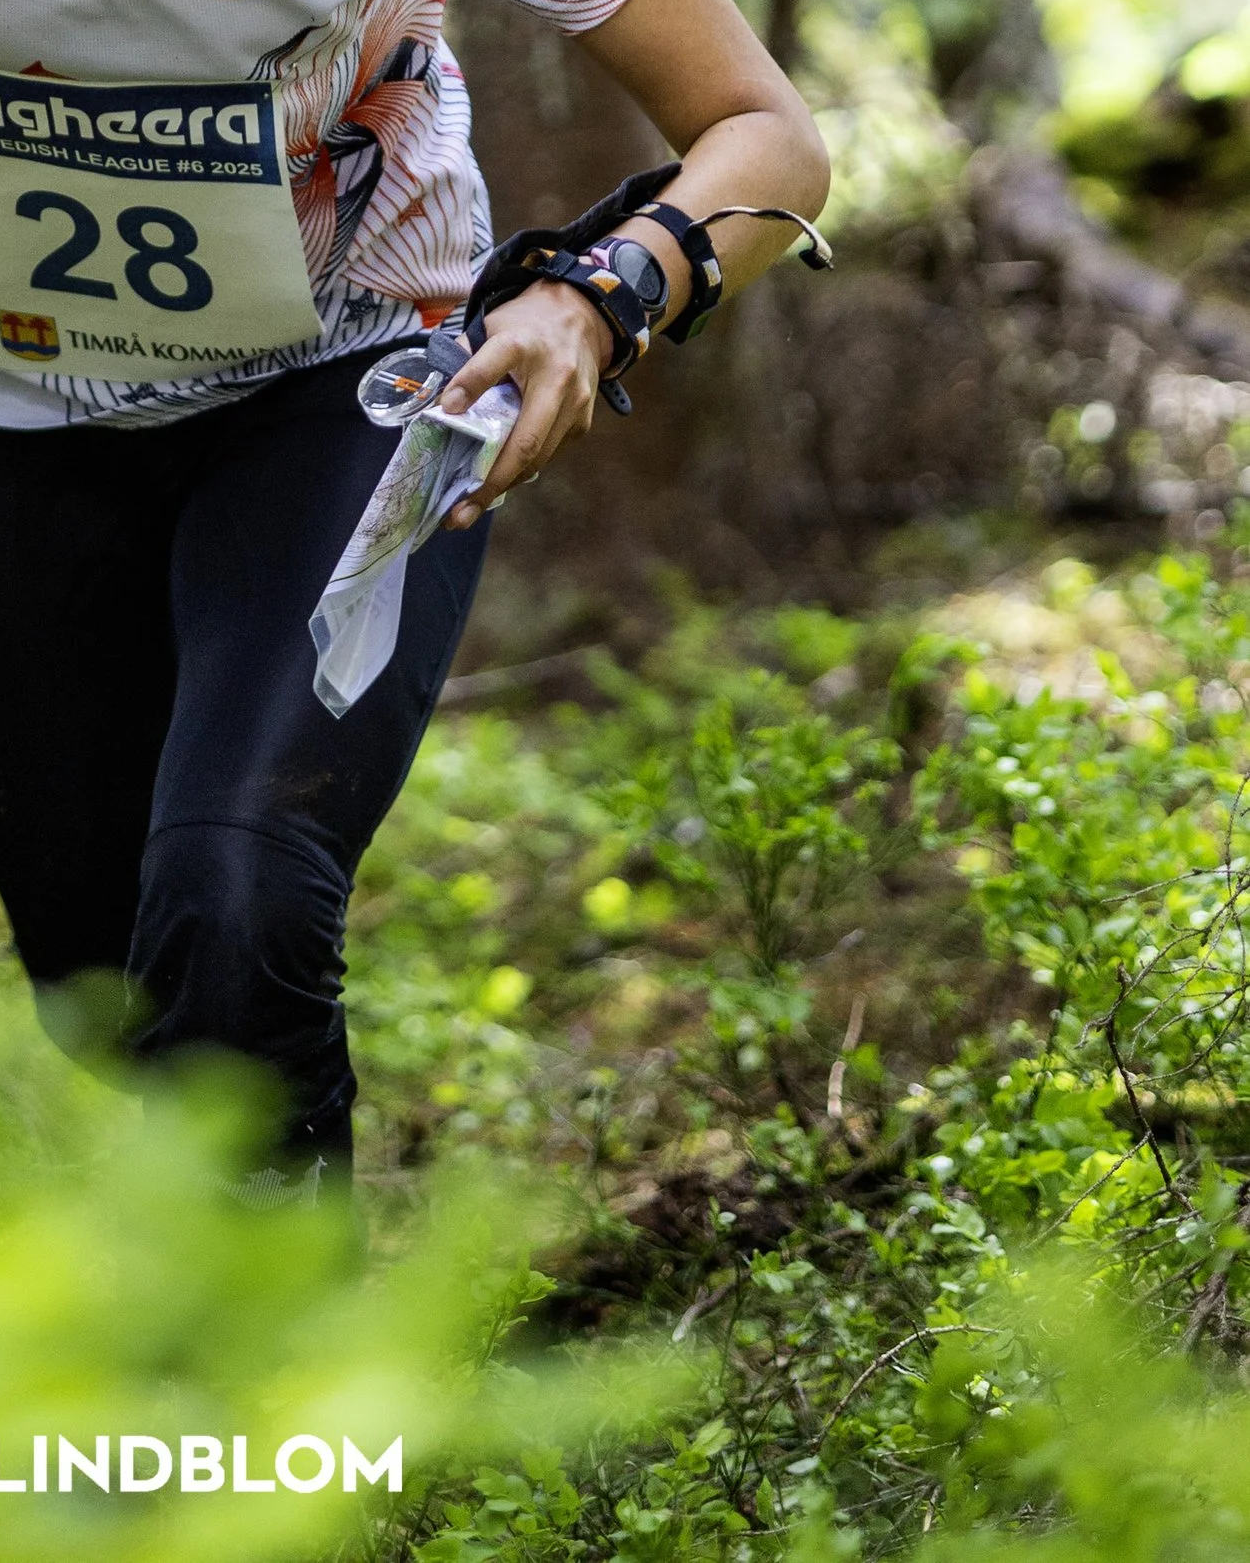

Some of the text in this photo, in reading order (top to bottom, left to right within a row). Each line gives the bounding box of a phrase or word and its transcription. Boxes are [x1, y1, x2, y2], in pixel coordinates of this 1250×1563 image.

[75, 150, 170, 174] LEAGUE
[176, 160, 204, 175] #6
[211, 160, 263, 177] 2025
[15, 190, 214, 312] 28
[66, 329, 147, 357] TIMRÅ
